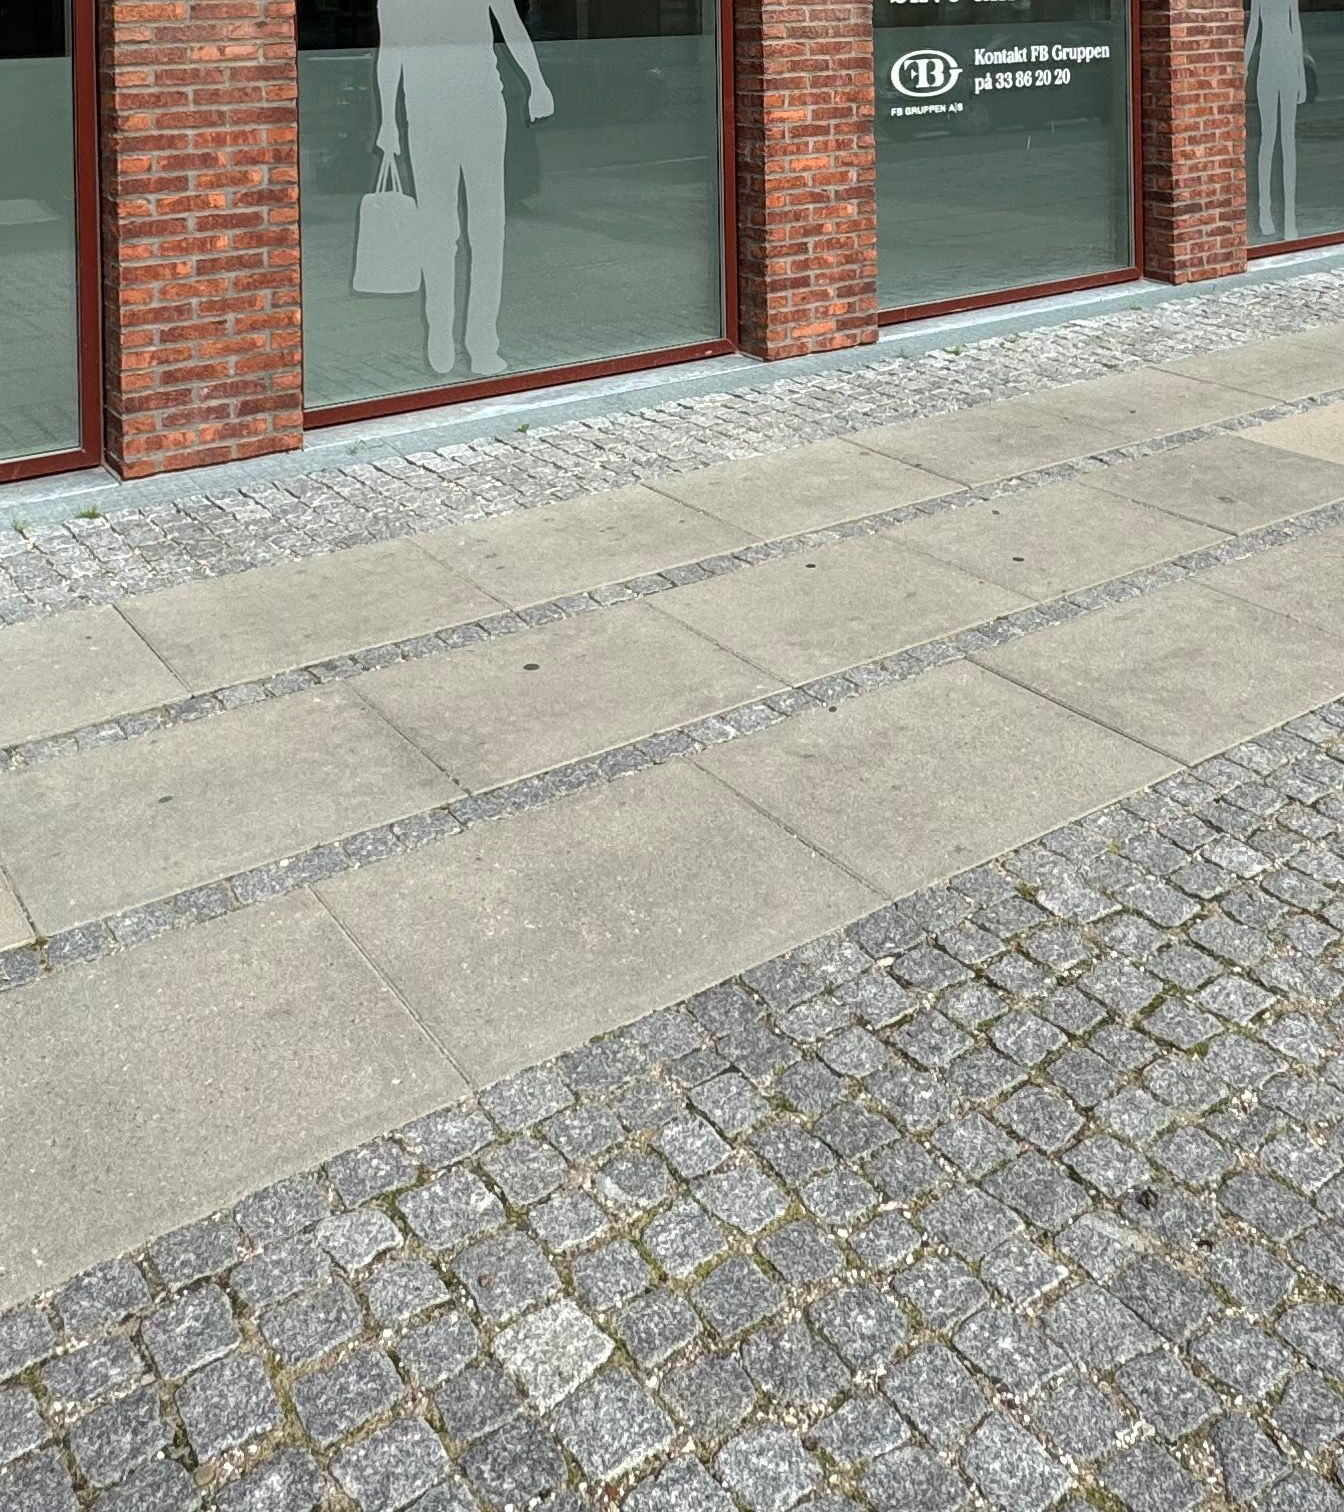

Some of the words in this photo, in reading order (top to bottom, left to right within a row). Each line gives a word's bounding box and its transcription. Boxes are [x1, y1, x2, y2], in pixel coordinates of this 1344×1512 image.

[974, 46, 1028, 65] Kontakt
[1030, 45, 1049, 62] FB
[1052, 44, 1110, 63] Gruppen
[974, 72, 993, 94] på
[995, 71, 1014, 89] 33
[1015, 70, 1033, 87] 86
[1035, 69, 1052, 86] 20
[1054, 68, 1071, 85] 20
[891, 108, 903, 116] FB
[905, 104, 946, 116] GRUPPEN
